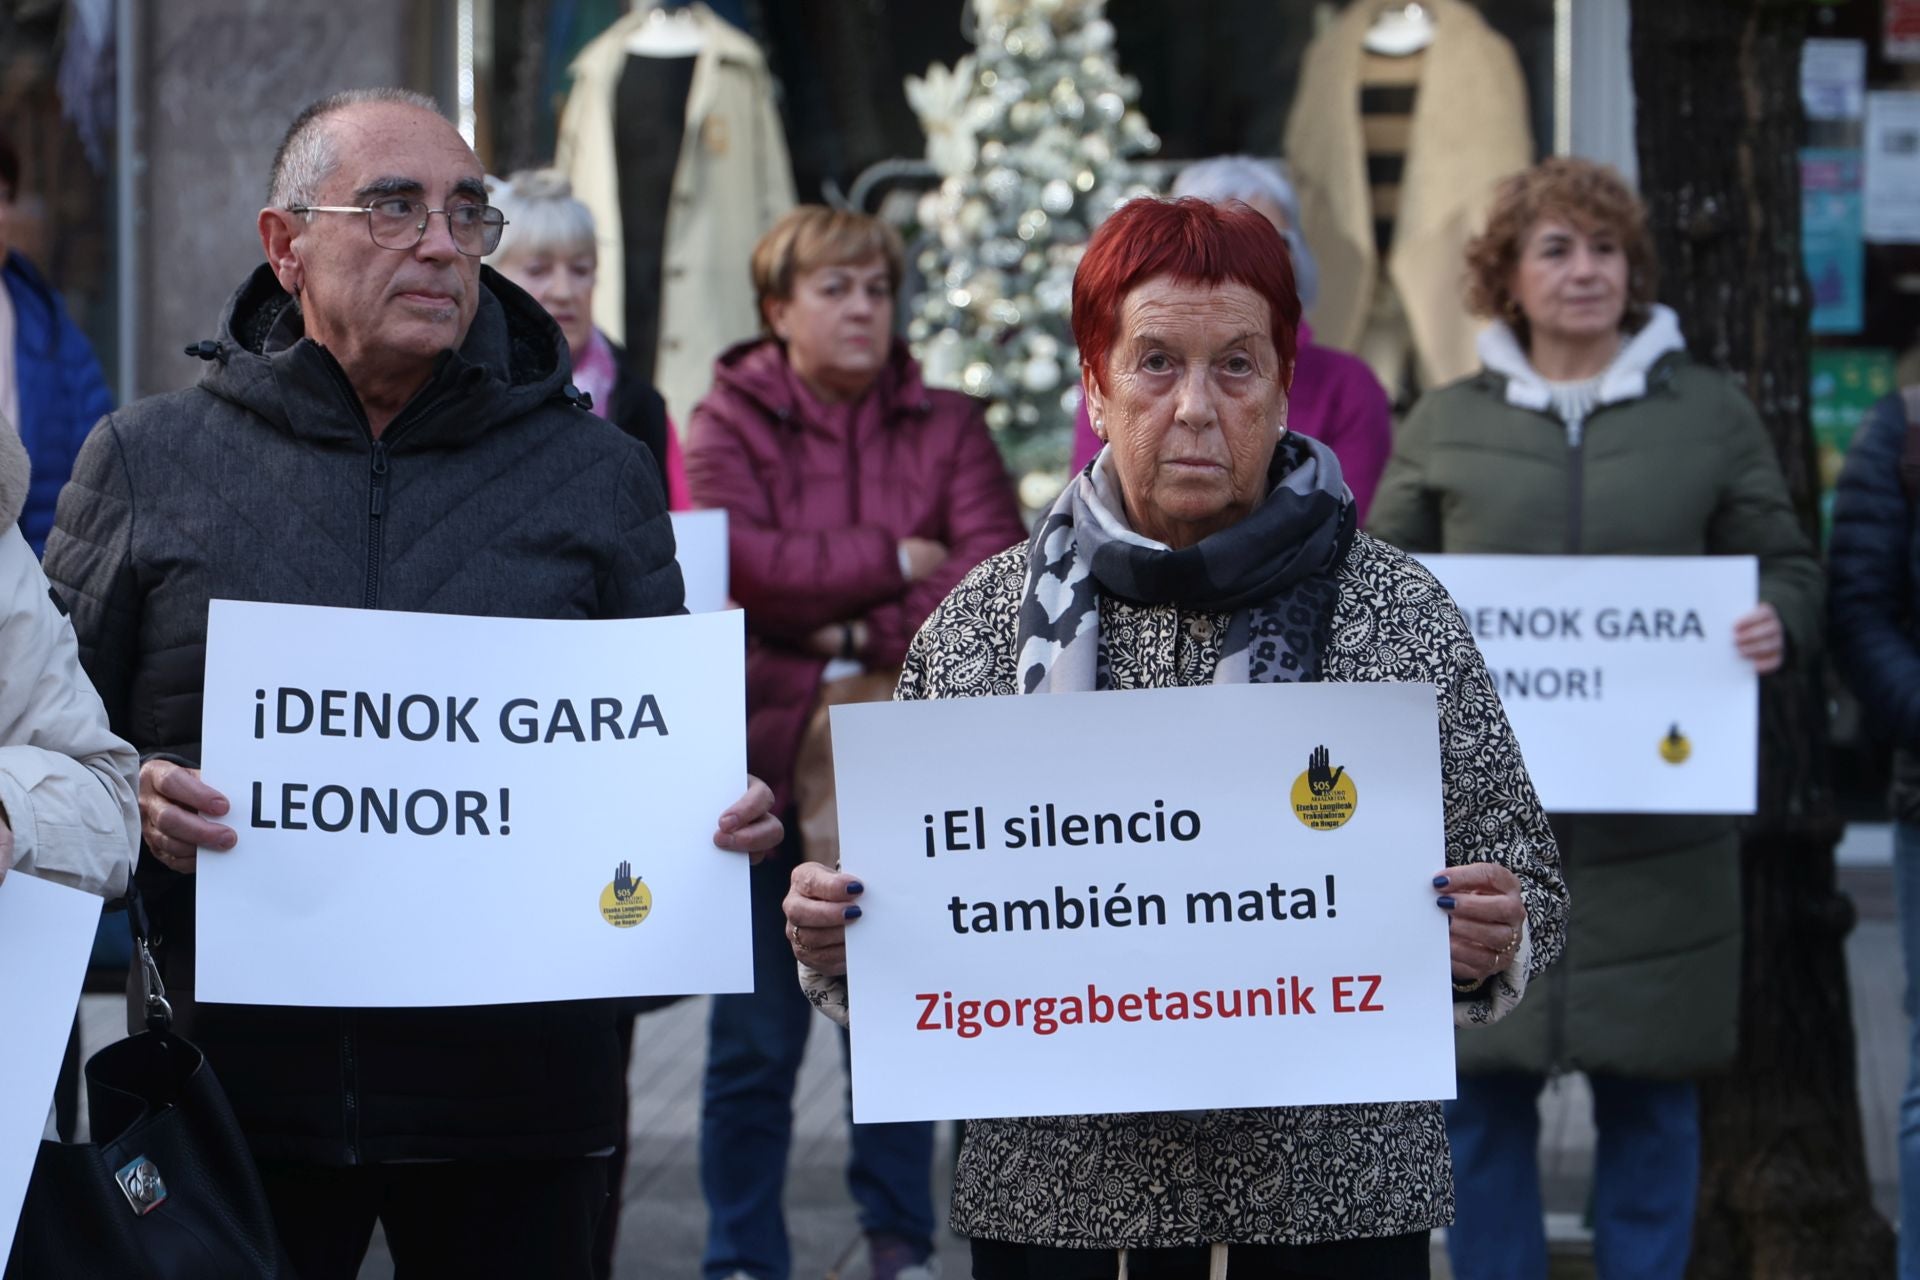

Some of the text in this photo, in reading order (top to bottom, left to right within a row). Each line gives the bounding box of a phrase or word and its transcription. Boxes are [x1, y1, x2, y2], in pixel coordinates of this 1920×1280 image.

[1594, 608, 1705, 639] GARA
[254, 686, 669, 745] ¡DENOK GARA
[250, 781, 511, 836] LEONOR!
[1313, 781, 1330, 790] SOS
[923, 799, 1201, 858] ¡El silencio
[617, 889, 631, 897] SOS
[947, 874, 1337, 935] también mata!
[915, 974, 1384, 1039] Zigorgabetasunik EZ
